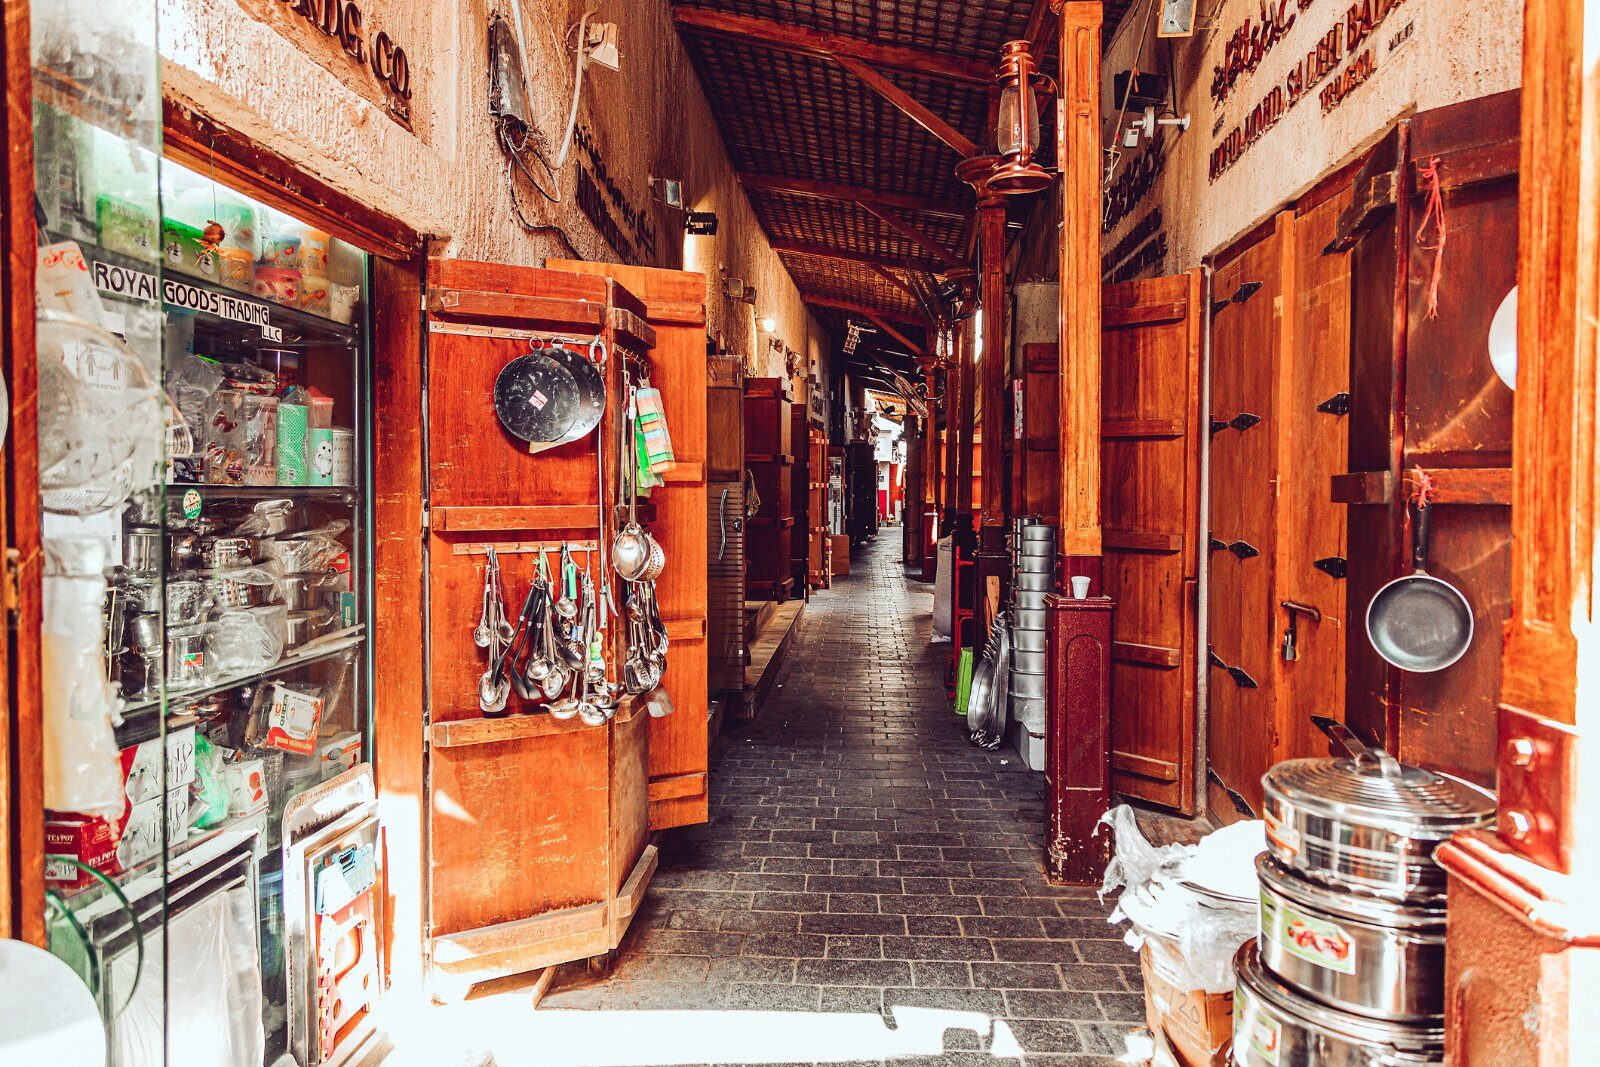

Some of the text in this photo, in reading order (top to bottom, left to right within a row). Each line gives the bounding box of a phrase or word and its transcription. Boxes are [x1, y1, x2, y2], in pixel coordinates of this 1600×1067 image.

[94, 263, 268, 326] ROYAL GOODS TRADING
[280, 693, 290, 727] QUEEN
[61, 834, 74, 842] POT
[88, 855, 101, 867] TEA
[102, 849, 116, 861] POT
